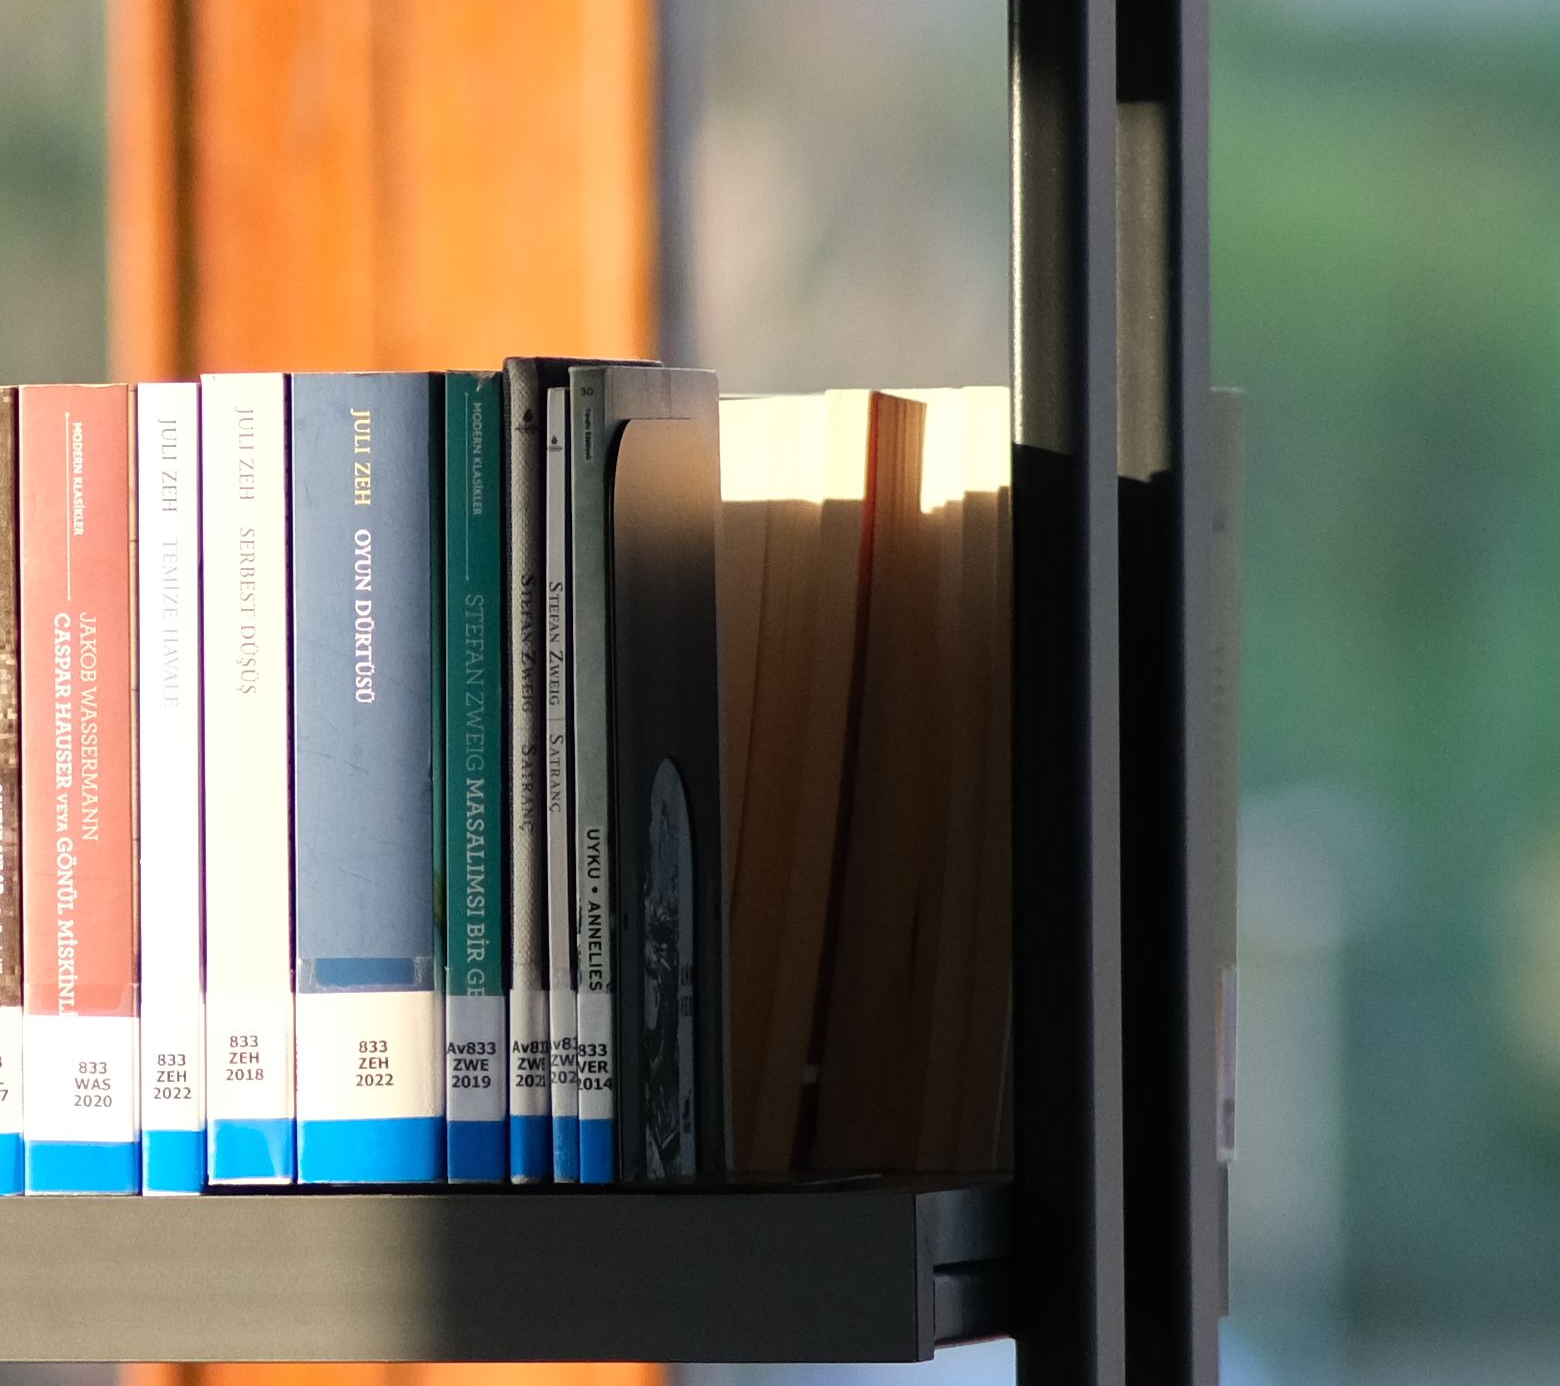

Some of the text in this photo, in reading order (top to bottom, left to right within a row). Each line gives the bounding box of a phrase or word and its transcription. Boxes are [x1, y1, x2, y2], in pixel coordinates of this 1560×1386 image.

[351, 408, 376, 704] JULI ZEH OYUN DÜRTÜSÜ
[78, 612, 101, 841] JAKOB WASSERMANN
[359, 1041, 387, 1053] 833
[447, 1042, 497, 1055] Av833
[358, 1057, 389, 1070] ZEH
[453, 1059, 489, 1071] ZWE
[355, 1074, 394, 1086] 2022
[451, 1076, 491, 1089] 2019
